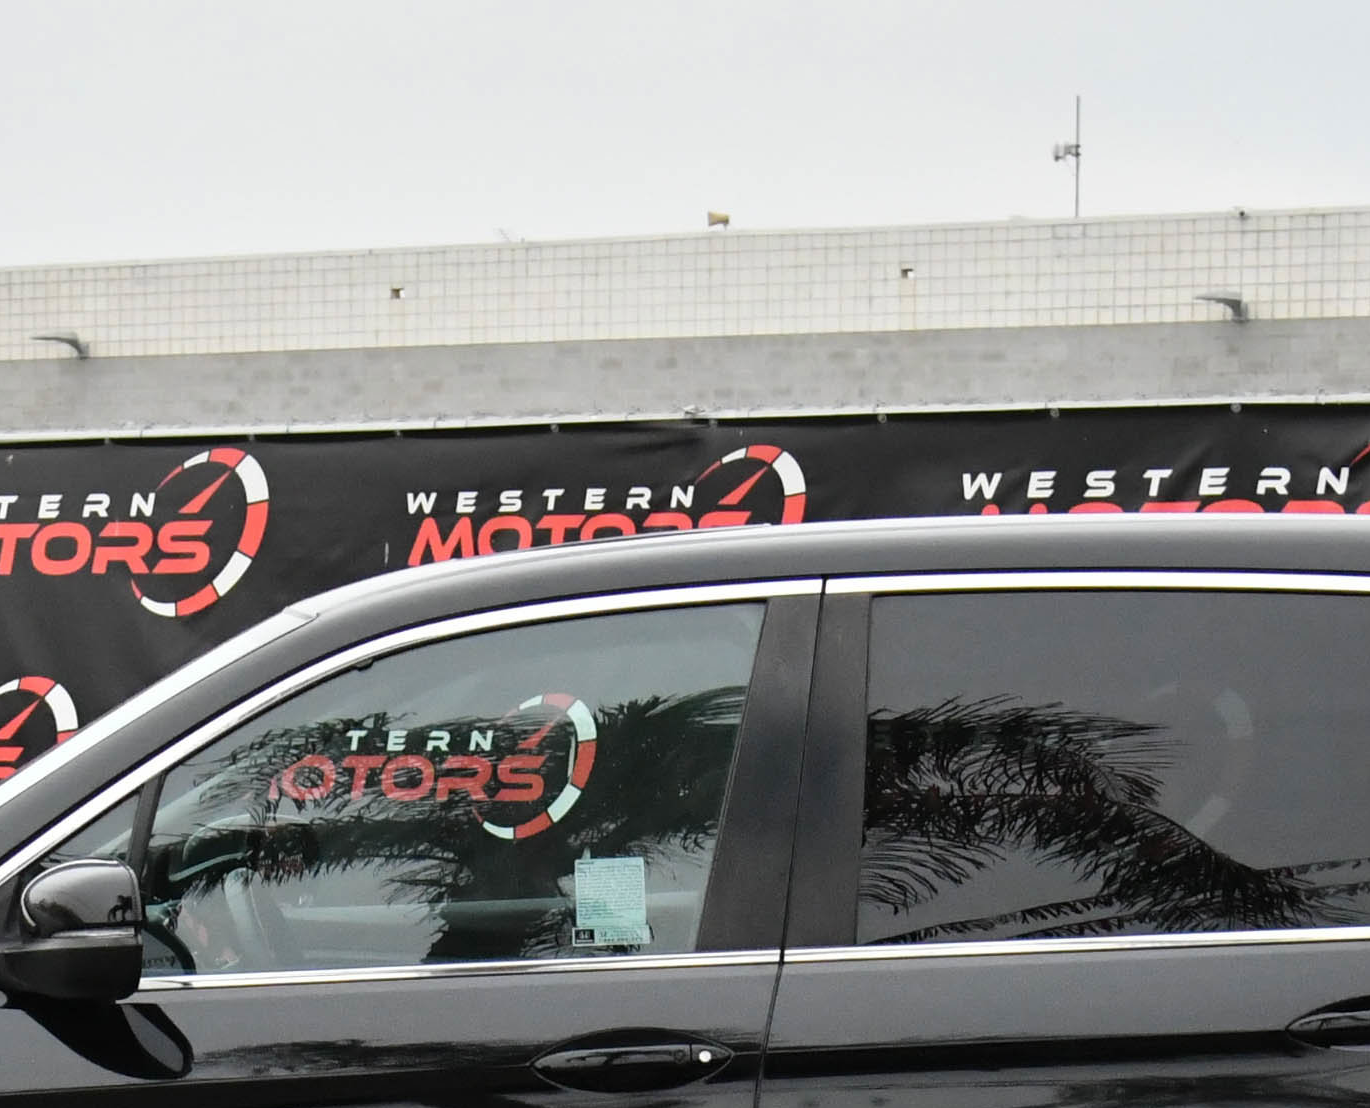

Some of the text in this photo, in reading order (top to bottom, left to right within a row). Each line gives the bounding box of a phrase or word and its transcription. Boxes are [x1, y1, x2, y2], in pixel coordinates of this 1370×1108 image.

[406, 485, 695, 514] WESTERN
[962, 466, 1350, 500] WESTERN
[271, 754, 546, 802] OTORS
